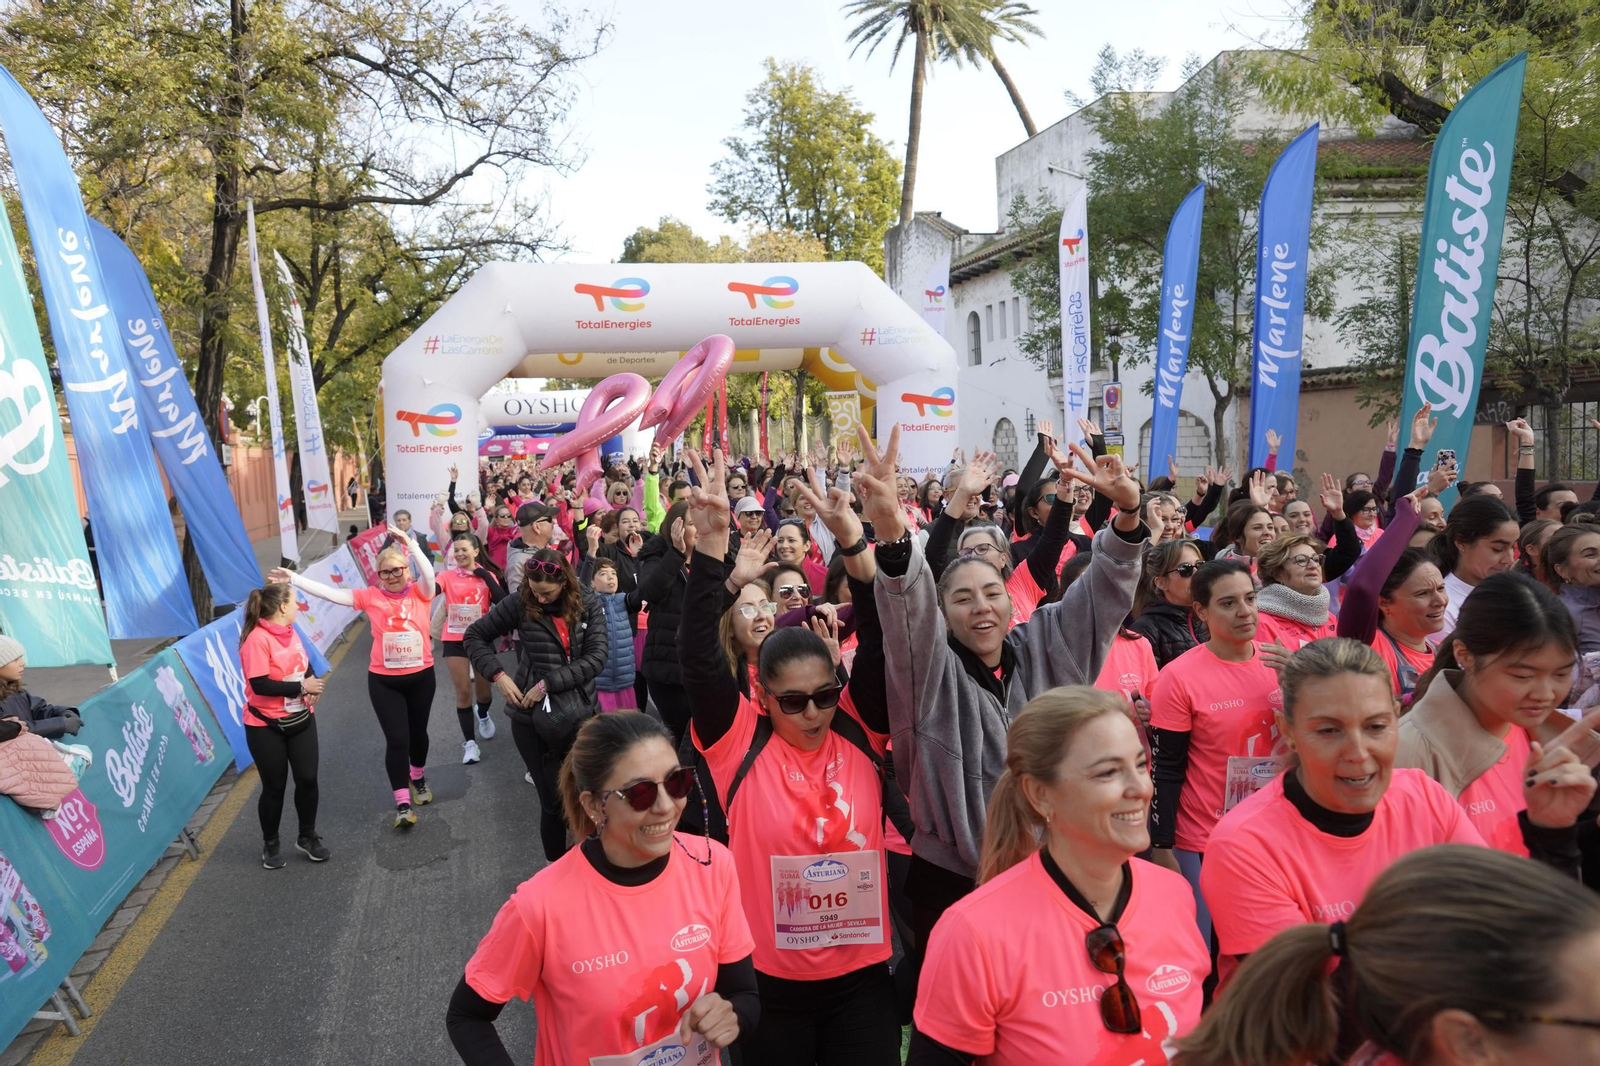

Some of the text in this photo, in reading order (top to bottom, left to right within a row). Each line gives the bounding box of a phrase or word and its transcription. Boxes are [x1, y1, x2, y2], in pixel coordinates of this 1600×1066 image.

[1414, 140, 1496, 419] Batiste
[728, 316, 801, 328] TotalEnergies
[1259, 242, 1300, 388] Marlene
[575, 319, 652, 331] TotalEnergies
[1159, 283, 1189, 408] Marlene
[619, 356, 656, 365] Deportes
[901, 423, 956, 433] TotalEnergies
[396, 443, 463, 454] TotalEnergies
[1210, 698, 1244, 712] OYSHO
[105, 701, 154, 808] Batiste
[72, 828, 99, 857] ESPAÑA
[806, 867, 846, 879] ASTURIANA
[809, 892, 848, 910] 016
[820, 914, 839, 923] 5949
[675, 932, 709, 949] ASTURIANA
[786, 932, 871, 945] OYSHO Santander
[572, 950, 629, 975] OYSHO
[1042, 984, 1105, 1008] OYSHO
